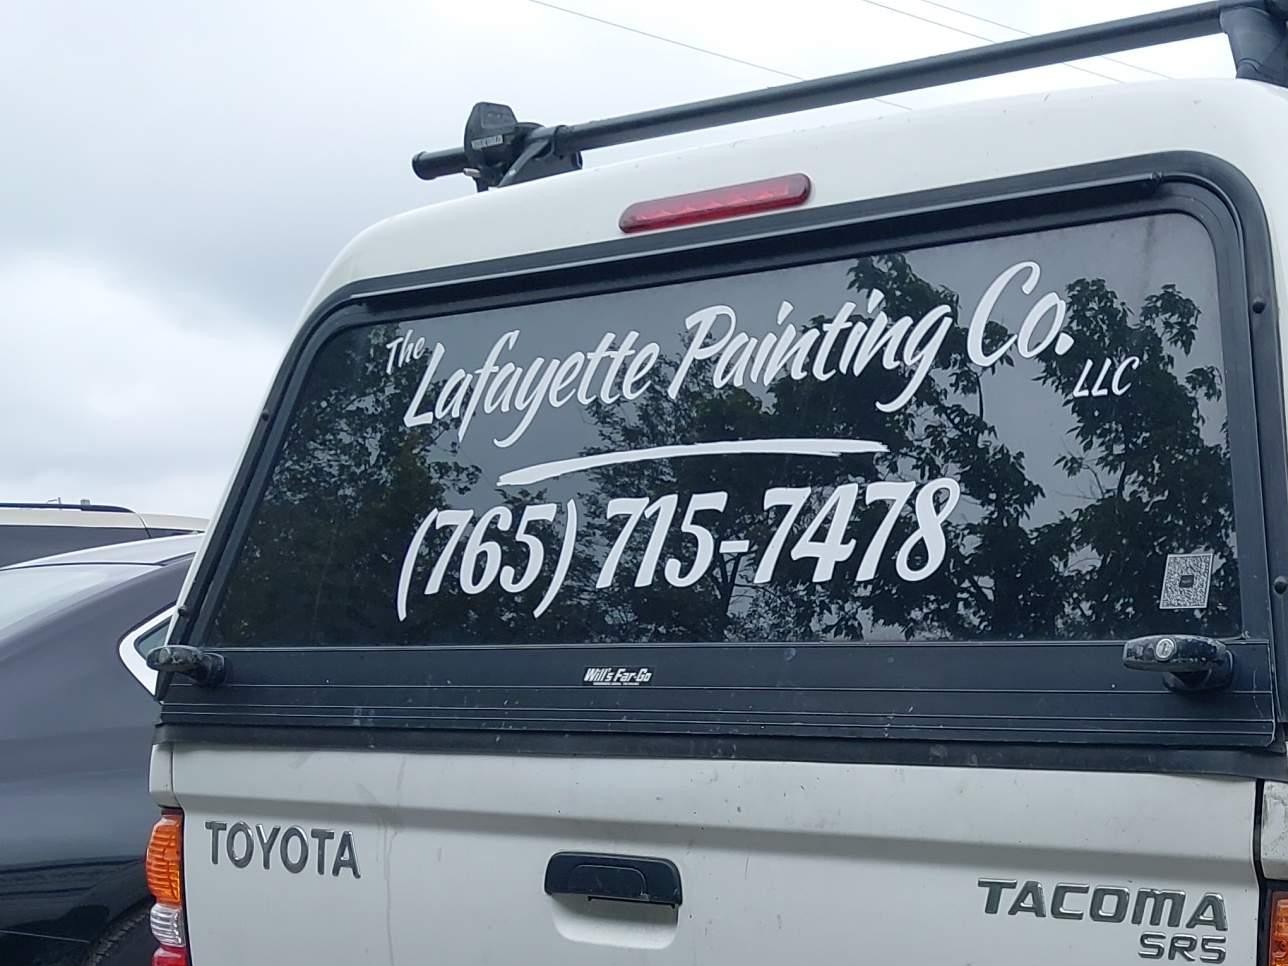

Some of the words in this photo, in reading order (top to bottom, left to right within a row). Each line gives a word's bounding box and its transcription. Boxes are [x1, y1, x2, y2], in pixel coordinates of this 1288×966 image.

[967, 261, 1075, 368] Co.
[386, 329, 425, 375] The
[668, 289, 953, 413] Painting
[1072, 356, 1140, 399] LLC
[403, 330, 660, 448] Lafayette
[397, 499, 578, 621] (765)
[596, 478, 961, 591] 715-7478
[583, 667, 615, 682] Will's
[613, 668, 652, 682] Far-Go
[205, 820, 361, 879] TOYOTA
[977, 878, 1228, 931] TACOMA
[1138, 932, 1226, 964] SR5
